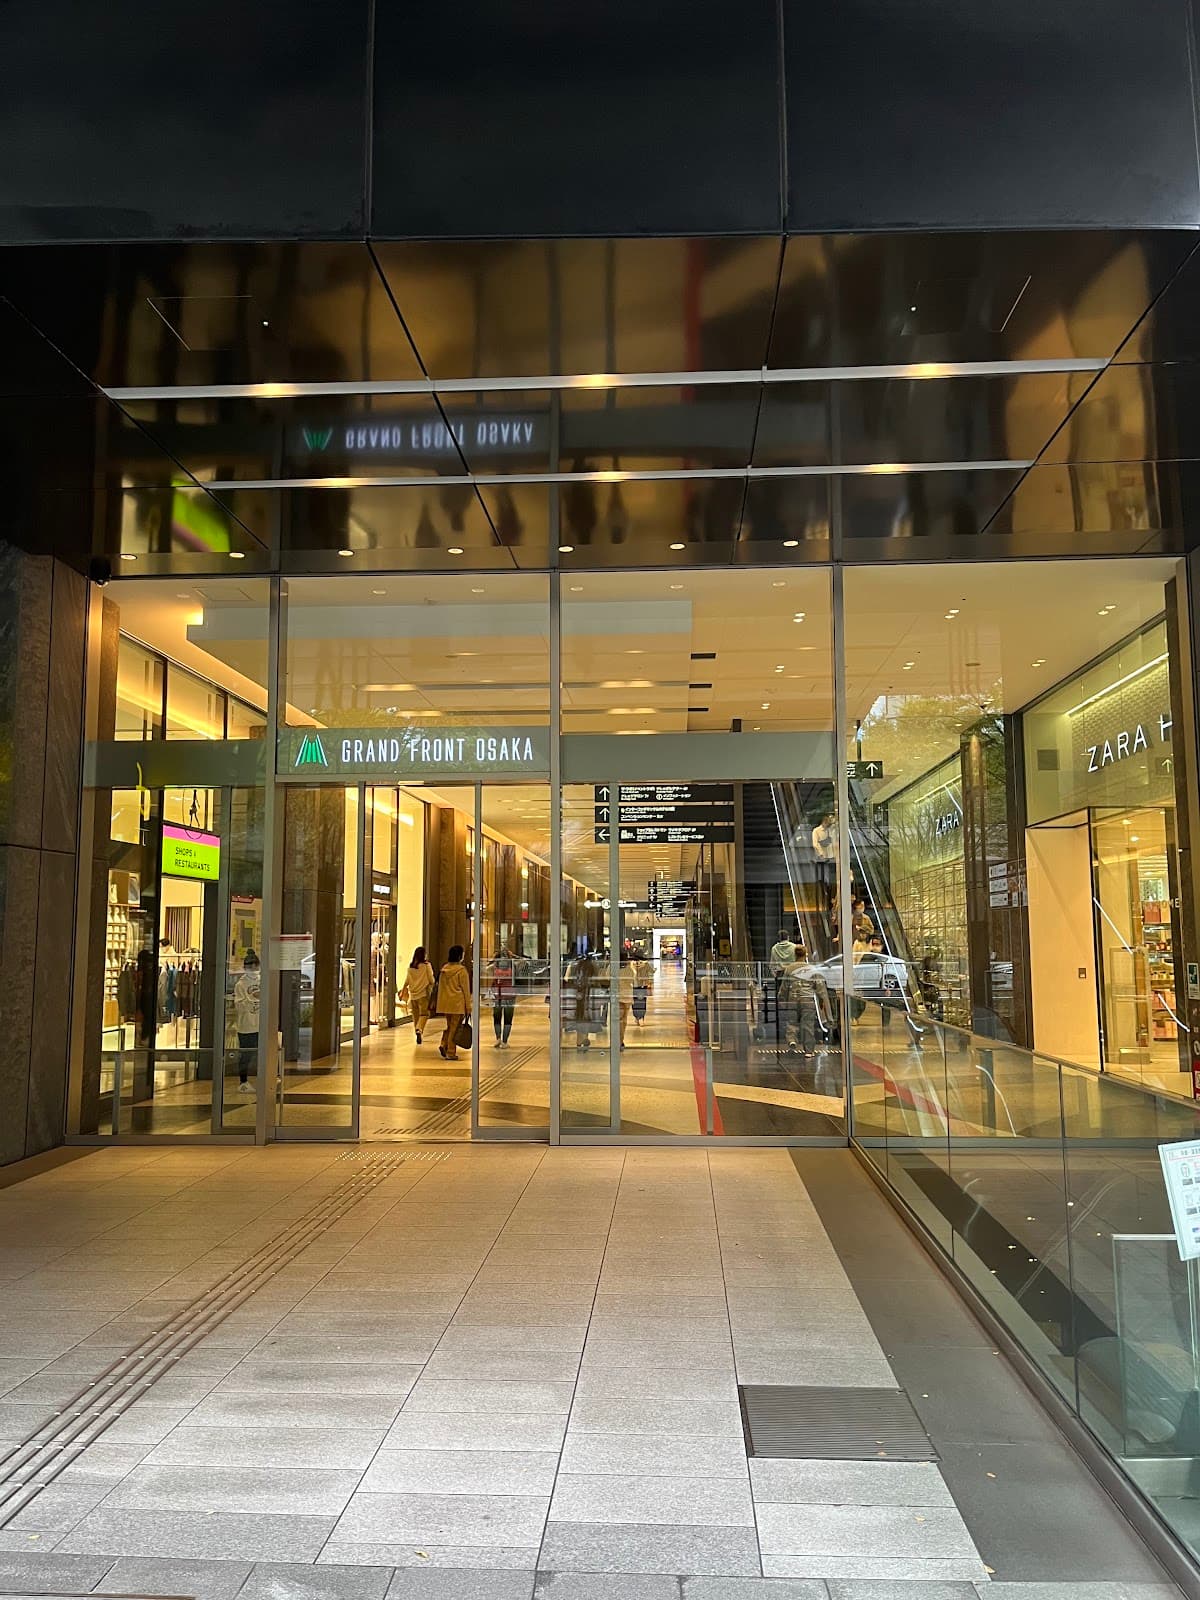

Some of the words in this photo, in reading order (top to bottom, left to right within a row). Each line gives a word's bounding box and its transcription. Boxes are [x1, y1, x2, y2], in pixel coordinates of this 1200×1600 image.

[341, 739, 399, 763] GRAND
[410, 739, 465, 762] FRONT
[476, 737, 534, 761] OSAKA
[1087, 724, 1147, 772] ZARA
[935, 810, 960, 835] ZARA
[175, 847, 192, 856] SHOPS
[175, 859, 210, 871] RESTAURANTS
